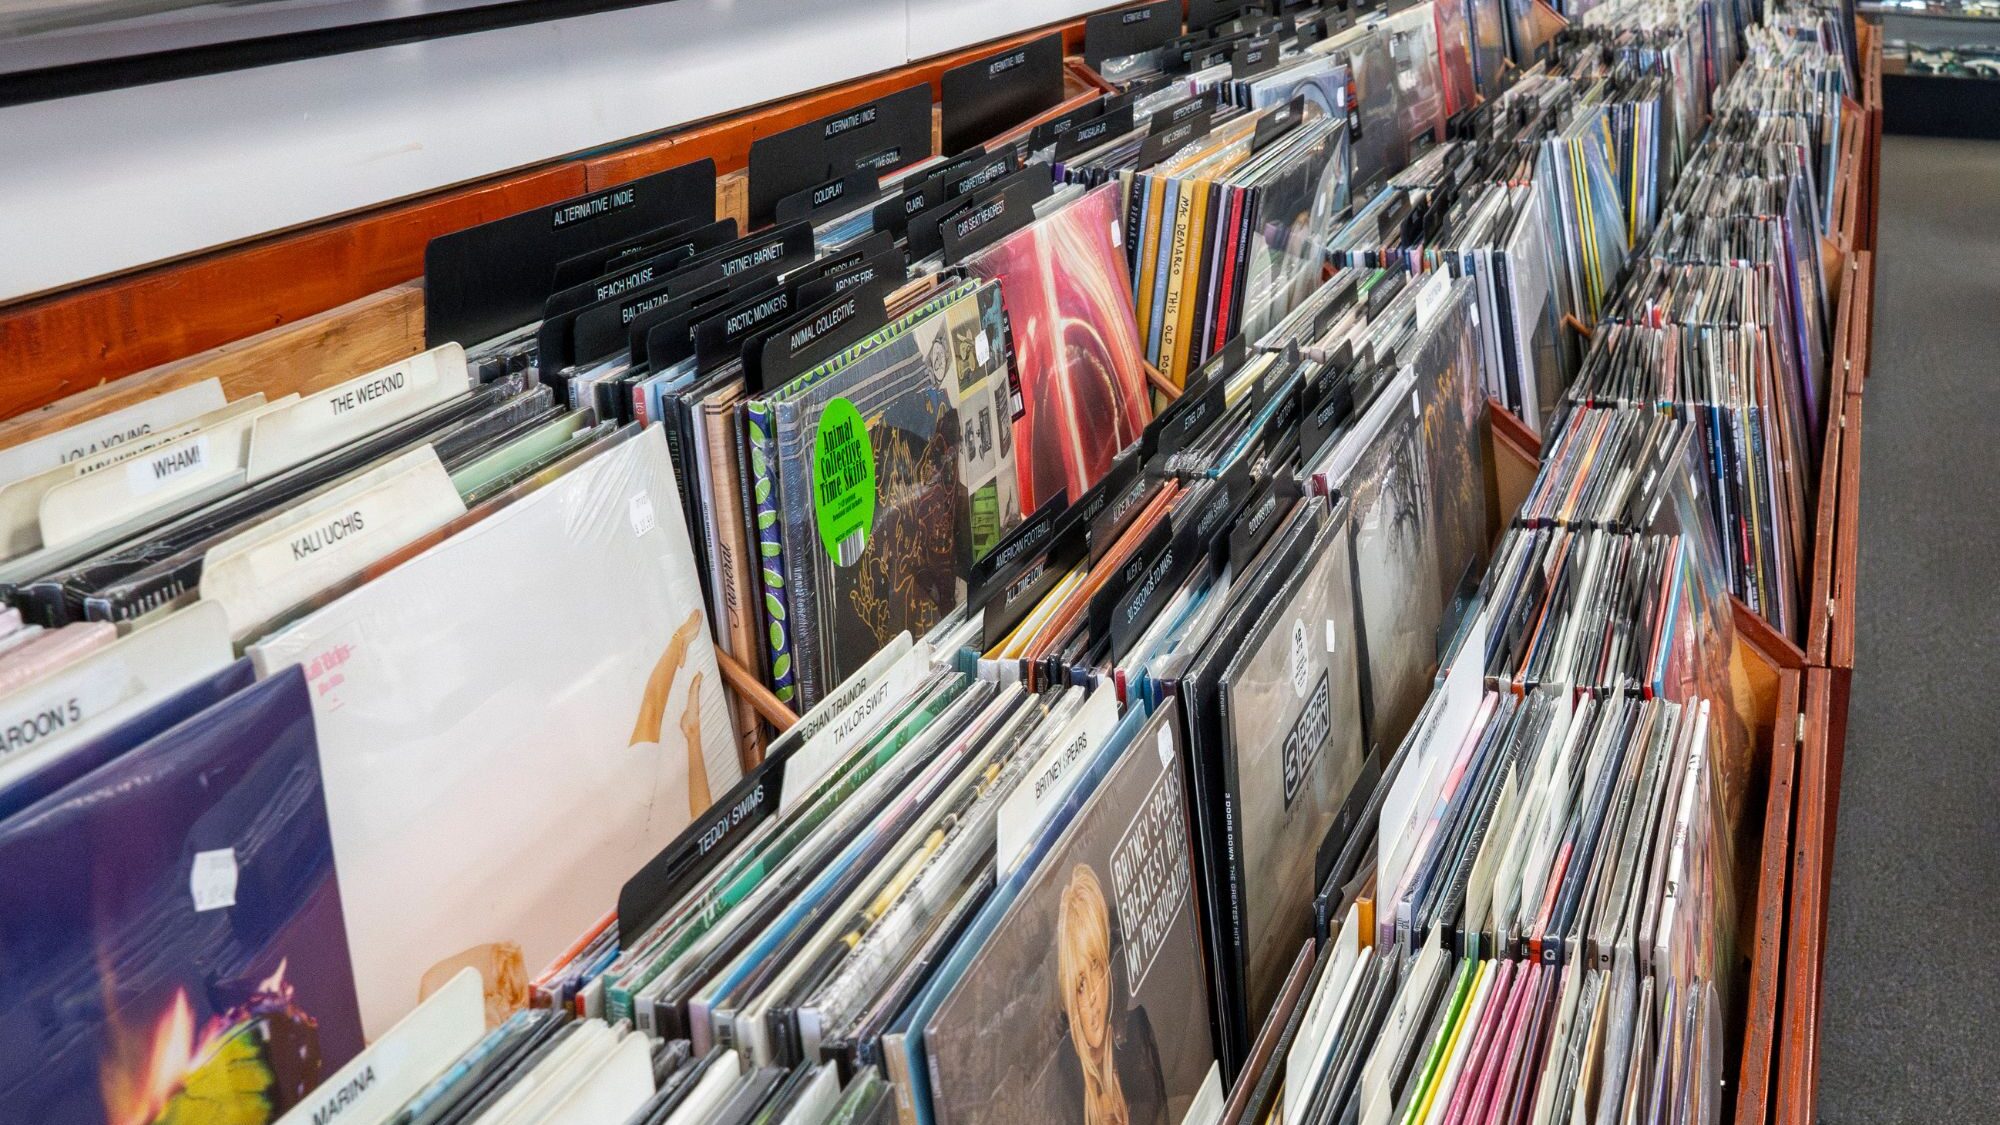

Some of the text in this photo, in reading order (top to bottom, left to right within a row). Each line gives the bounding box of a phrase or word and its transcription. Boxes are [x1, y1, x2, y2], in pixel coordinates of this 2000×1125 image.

[825, 113, 860, 136] ALTERNATIVE
[554, 196, 609, 227] ALTERNATIVE
[613, 188, 634, 208] INDIE
[814, 182, 843, 204] COLDPLAY
[905, 195, 924, 213] CLAIRO
[957, 220, 969, 237] CAR
[968, 213, 981, 231] SEAT
[981, 199, 1005, 224] HEADREST
[753, 242, 785, 265] BARNETT
[1173, 223, 1187, 276] DEMARCO
[625, 267, 654, 290] HOUSE
[727, 310, 753, 336] ARCTIC
[753, 293, 788, 322] MONKEYS
[1167, 290, 1179, 314] THIS
[790, 299, 856, 351] ANIMAL COLLECTIVE
[1164, 325, 1174, 346] OLD
[330, 371, 405, 417] THE WEEKND
[822, 416, 854, 456] Animal
[152, 445, 201, 479] WHAM!
[820, 438, 862, 482] Collective
[819, 475, 843, 508] Time
[291, 511, 365, 562] KALI UCHIS
[995, 520, 1051, 570] AMERICAN FOOTBALL
[1132, 579, 1153, 615] SECONDS
[1159, 549, 1173, 577] MARS
[67, 698, 81, 722] 5
[801, 709, 830, 742] EGHAN
[830, 677, 868, 717] TRAINOR
[833, 681, 890, 745] TAYLOR SWIFT
[1285, 732, 1299, 800] 3
[1299, 683, 1328, 743] DOORS
[1300, 705, 1328, 770] DOWN
[1035, 731, 1088, 800] BRITNEY SPEARS
[697, 784, 765, 857] TEDDY SWIMS
[1114, 763, 1180, 899] BRITNEY SPEARS
[1227, 833, 1235, 862] DOWN
[1121, 838, 1166, 942] GREATEST
[1127, 940, 1143, 984] MY
[311, 1065, 376, 1125] MARINA
